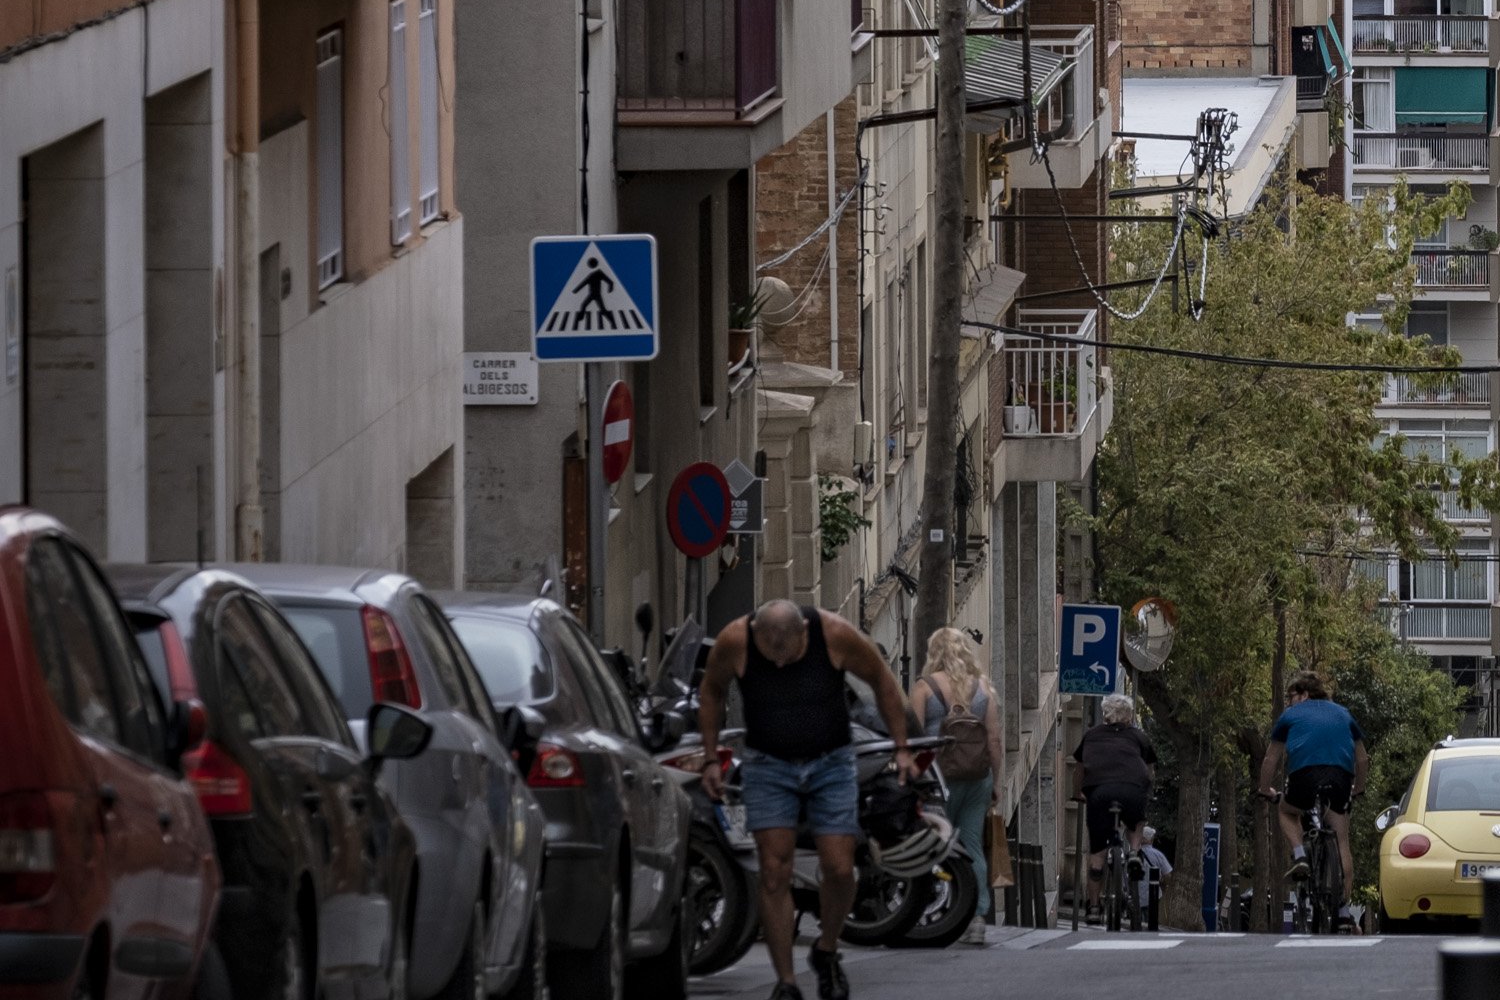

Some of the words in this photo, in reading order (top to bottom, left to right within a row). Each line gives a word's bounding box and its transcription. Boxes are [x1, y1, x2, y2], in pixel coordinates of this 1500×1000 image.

[472, 359, 516, 369] CARRER
[480, 371, 509, 381] DELS
[462, 383, 528, 395] ALBIGESOS
[730, 499, 748, 508] rea
[1072, 613, 1107, 656] P
